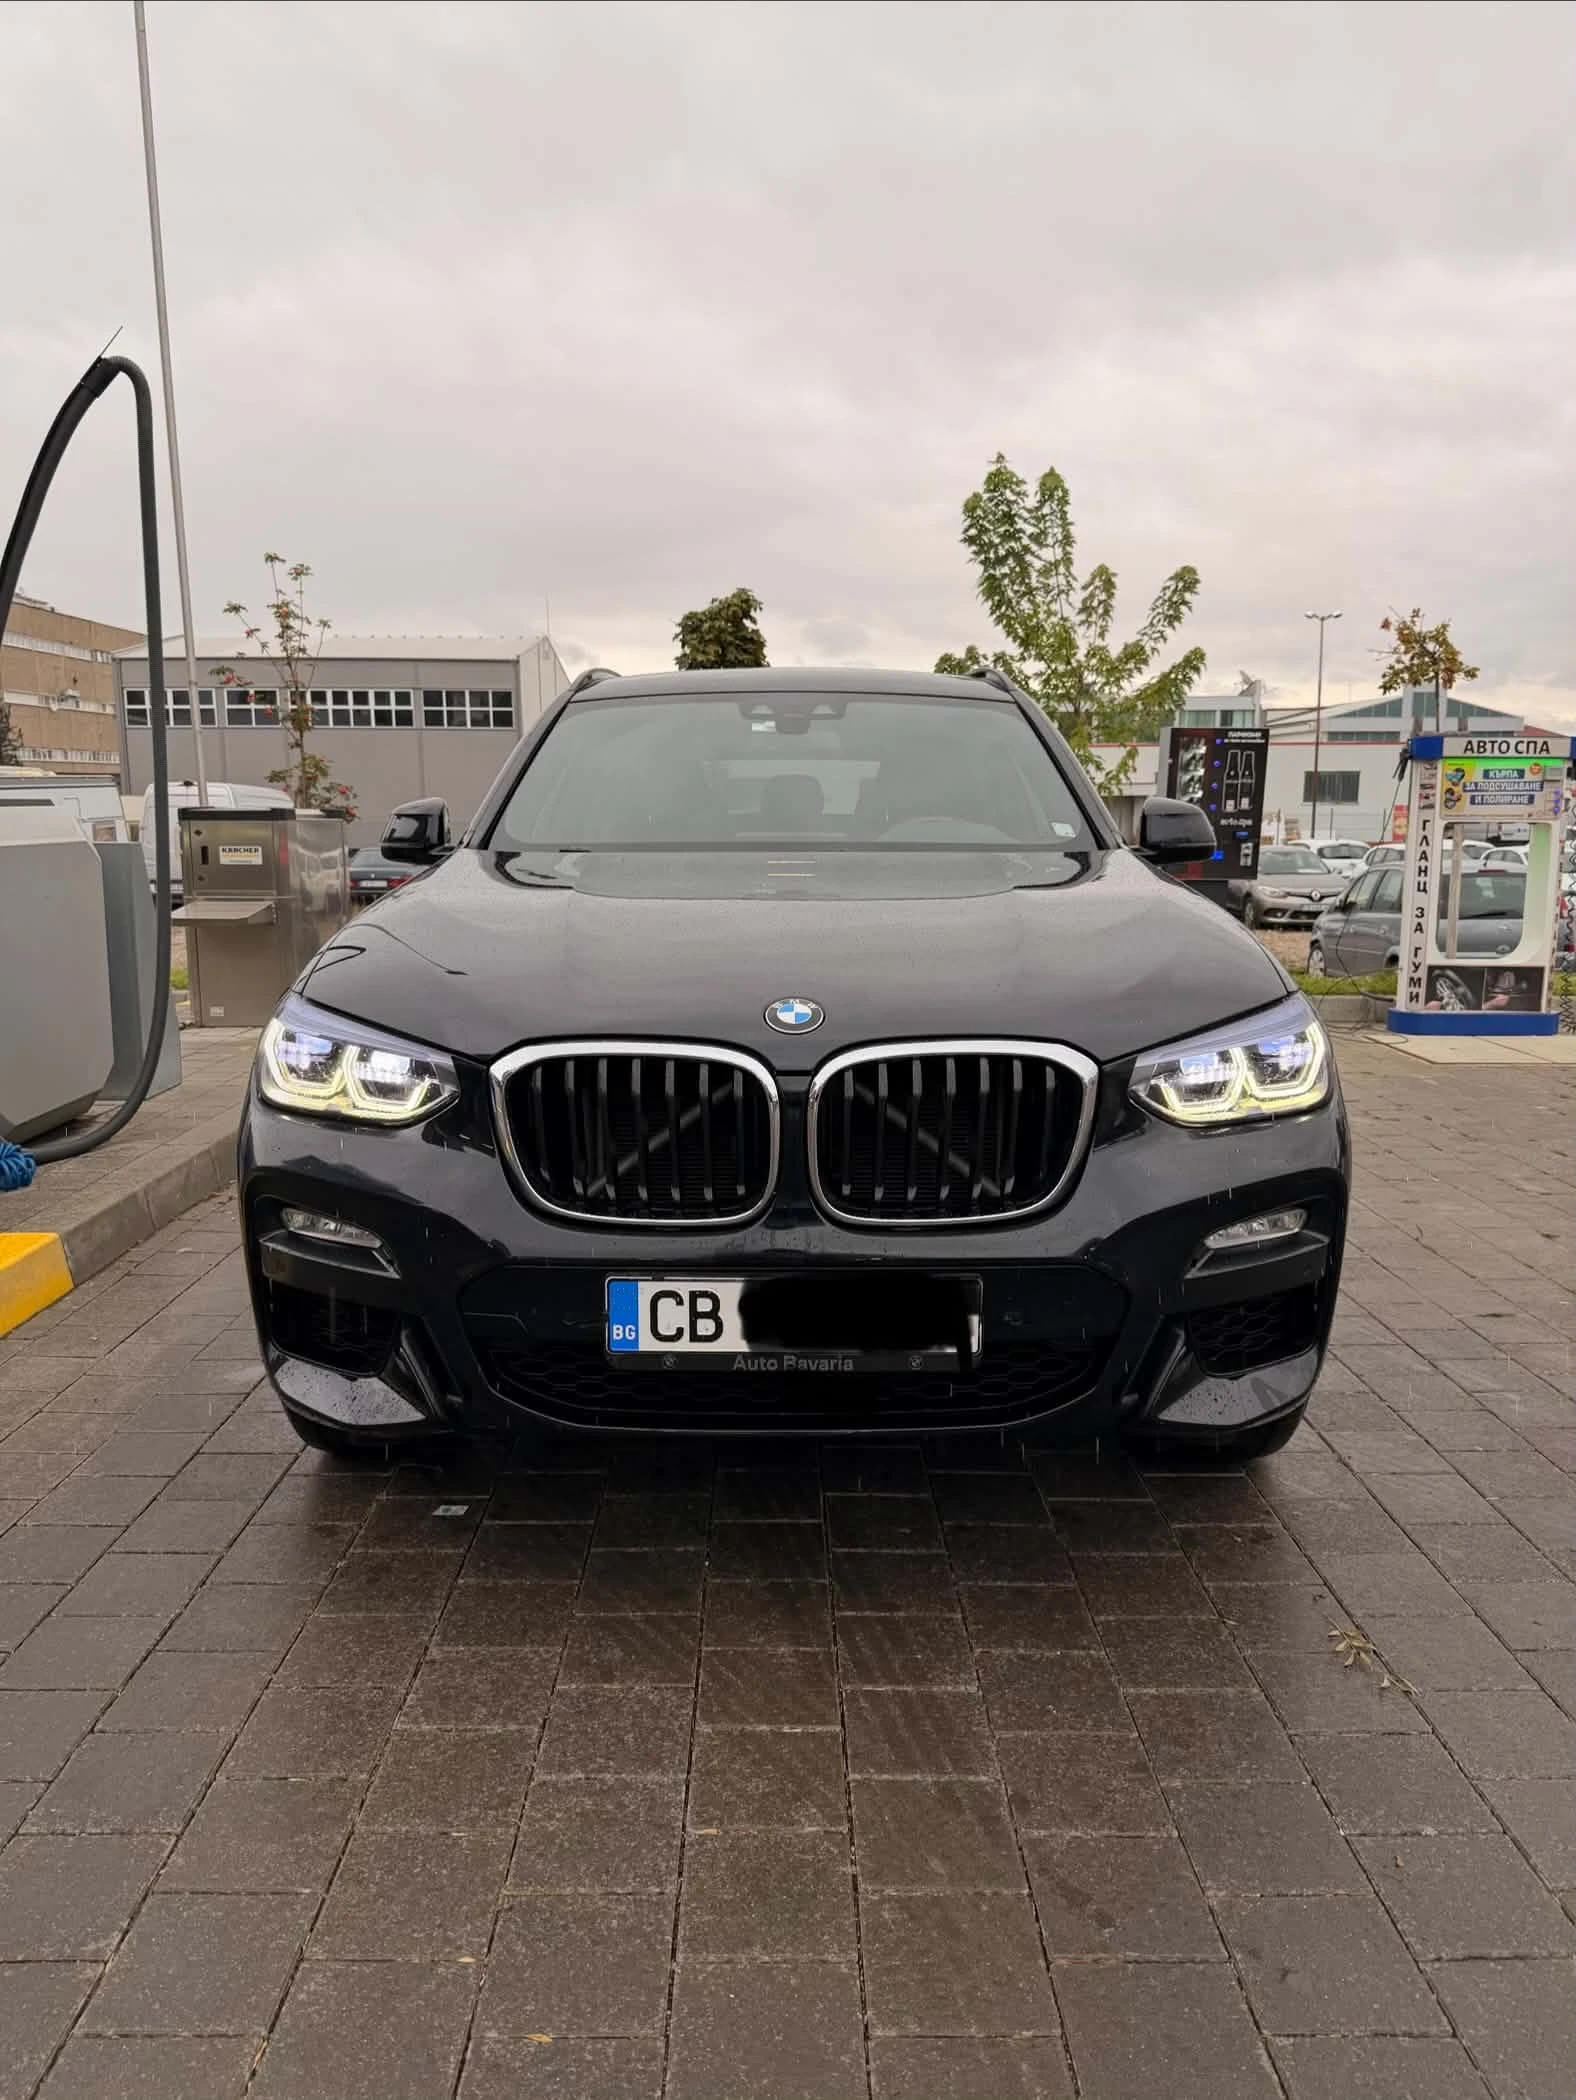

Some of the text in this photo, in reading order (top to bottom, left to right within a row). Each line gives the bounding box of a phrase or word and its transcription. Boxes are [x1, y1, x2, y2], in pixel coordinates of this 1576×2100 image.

[1463, 740, 1551, 755] АВТО СПА
[1488, 769, 1519, 778] КЪРПА
[1408, 819, 1431, 1003] ГЛАНЦ ЗА ГУМИ
[612, 1323, 636, 1341] BG
[732, 1353, 854, 1371] Auto Bavaria
